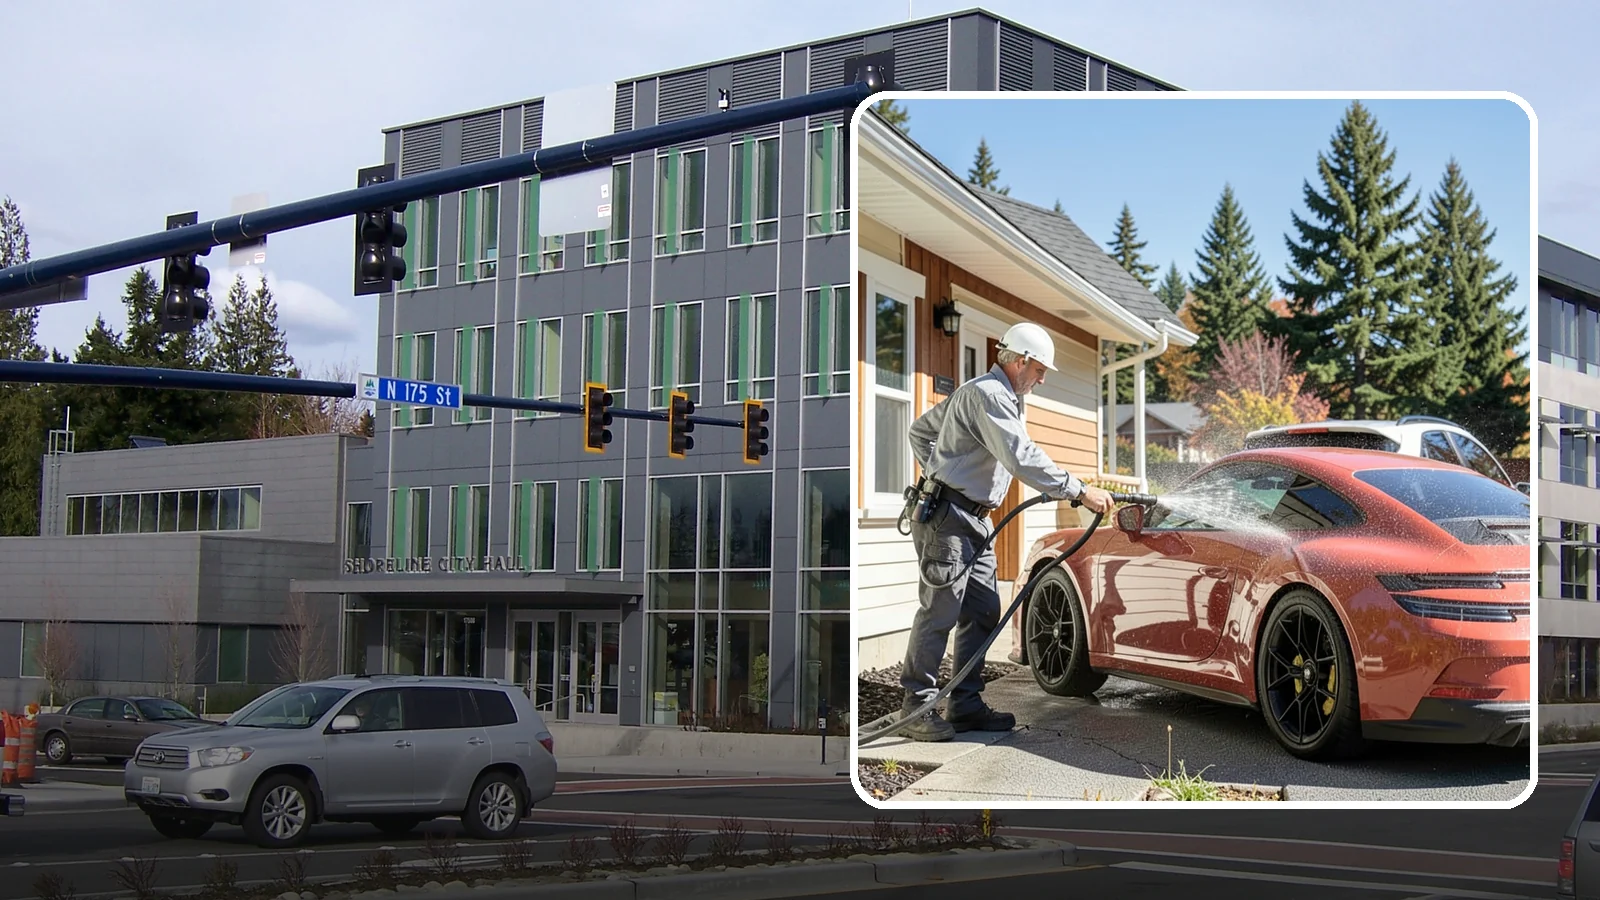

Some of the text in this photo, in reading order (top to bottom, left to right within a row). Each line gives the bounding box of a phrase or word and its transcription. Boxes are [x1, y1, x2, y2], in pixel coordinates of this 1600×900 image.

[386, 380, 451, 406] N 175 St
[344, 555, 525, 574] SHORELINE CITY HALL
